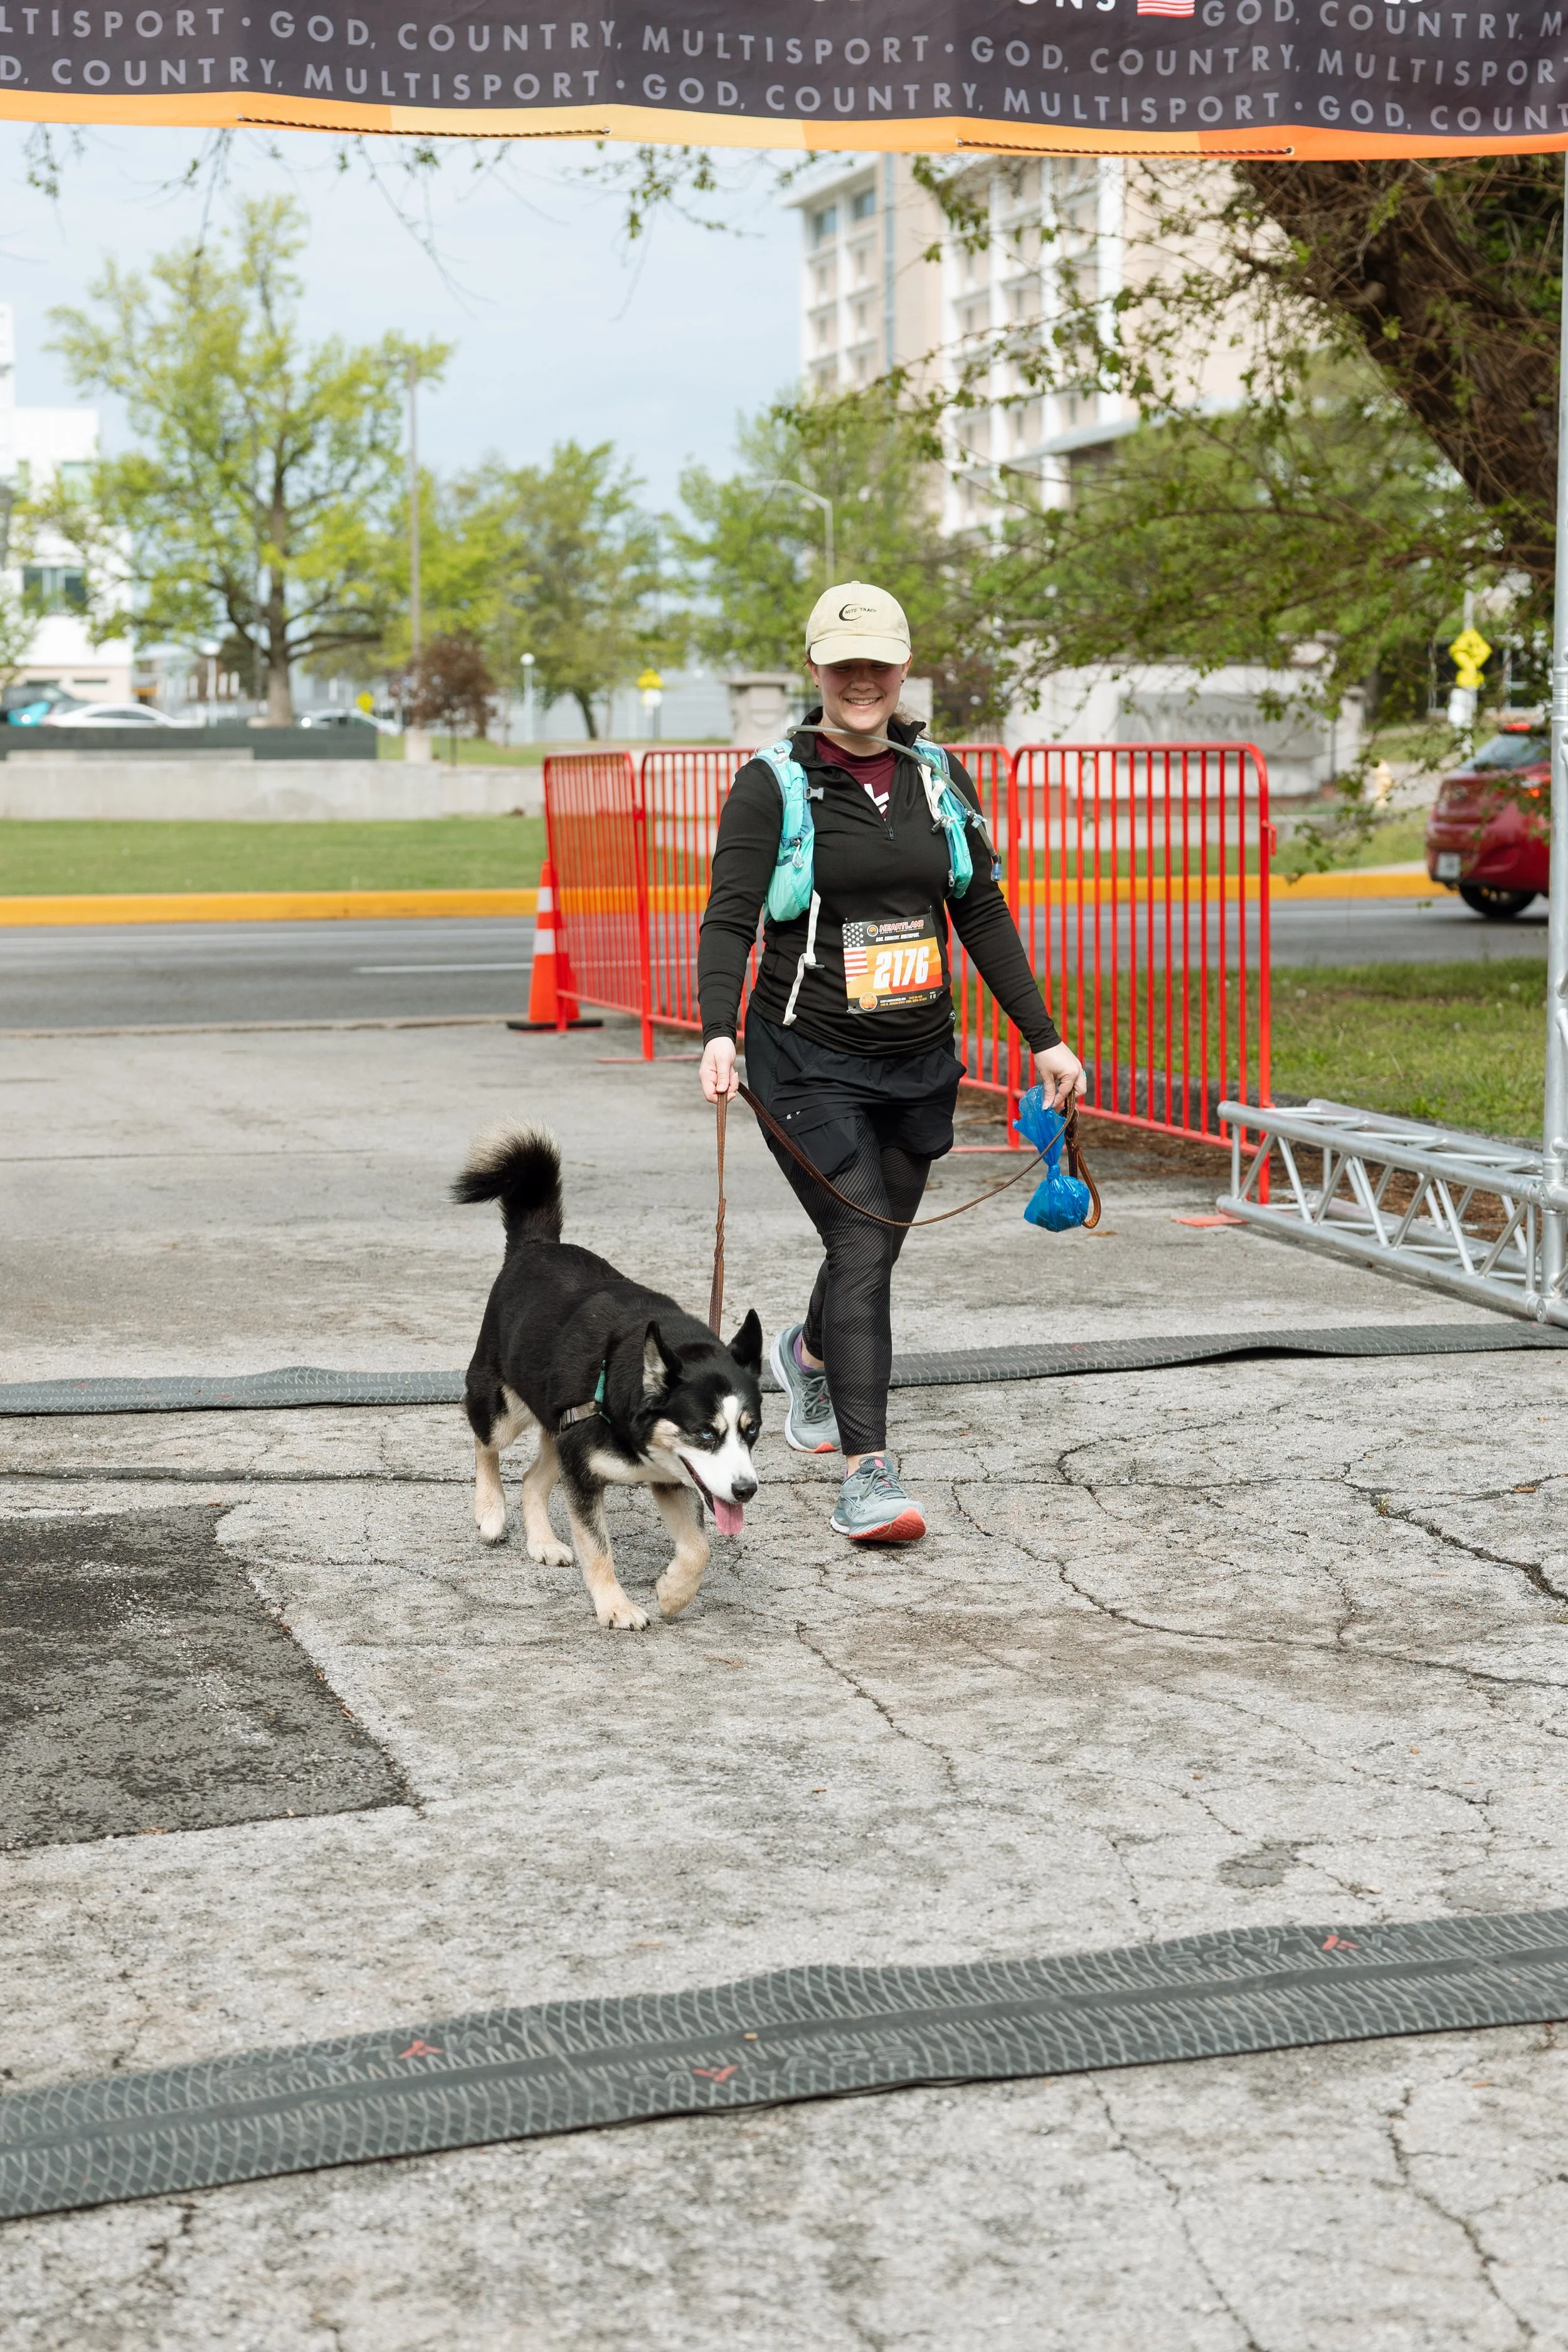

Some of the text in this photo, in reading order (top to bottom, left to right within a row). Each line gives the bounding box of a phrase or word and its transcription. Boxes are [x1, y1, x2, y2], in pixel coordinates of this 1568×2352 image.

[0, 5, 225, 38] LTISPORT
[269, 10, 376, 50] GOD,
[397, 20, 622, 53] COUNTRY,
[642, 24, 929, 66] MULTISPORT
[971, 36, 1069, 73] GOD,
[1089, 44, 1301, 76] COUNTRY,
[1202, 0, 1562, 40] GOD, COUNTRY, M
[0, 55, 29, 84] D,
[51, 56, 283, 88] COUNTRY,
[304, 63, 600, 100] MULTISPORT
[642, 73, 745, 109] GOD,
[765, 82, 983, 112] COUNTRY,
[1003, 87, 1280, 123] MULTISPORT
[1318, 95, 1412, 129] GOD,
[879, 919, 924, 933] HEARTLAND
[872, 945, 930, 989] 2176
